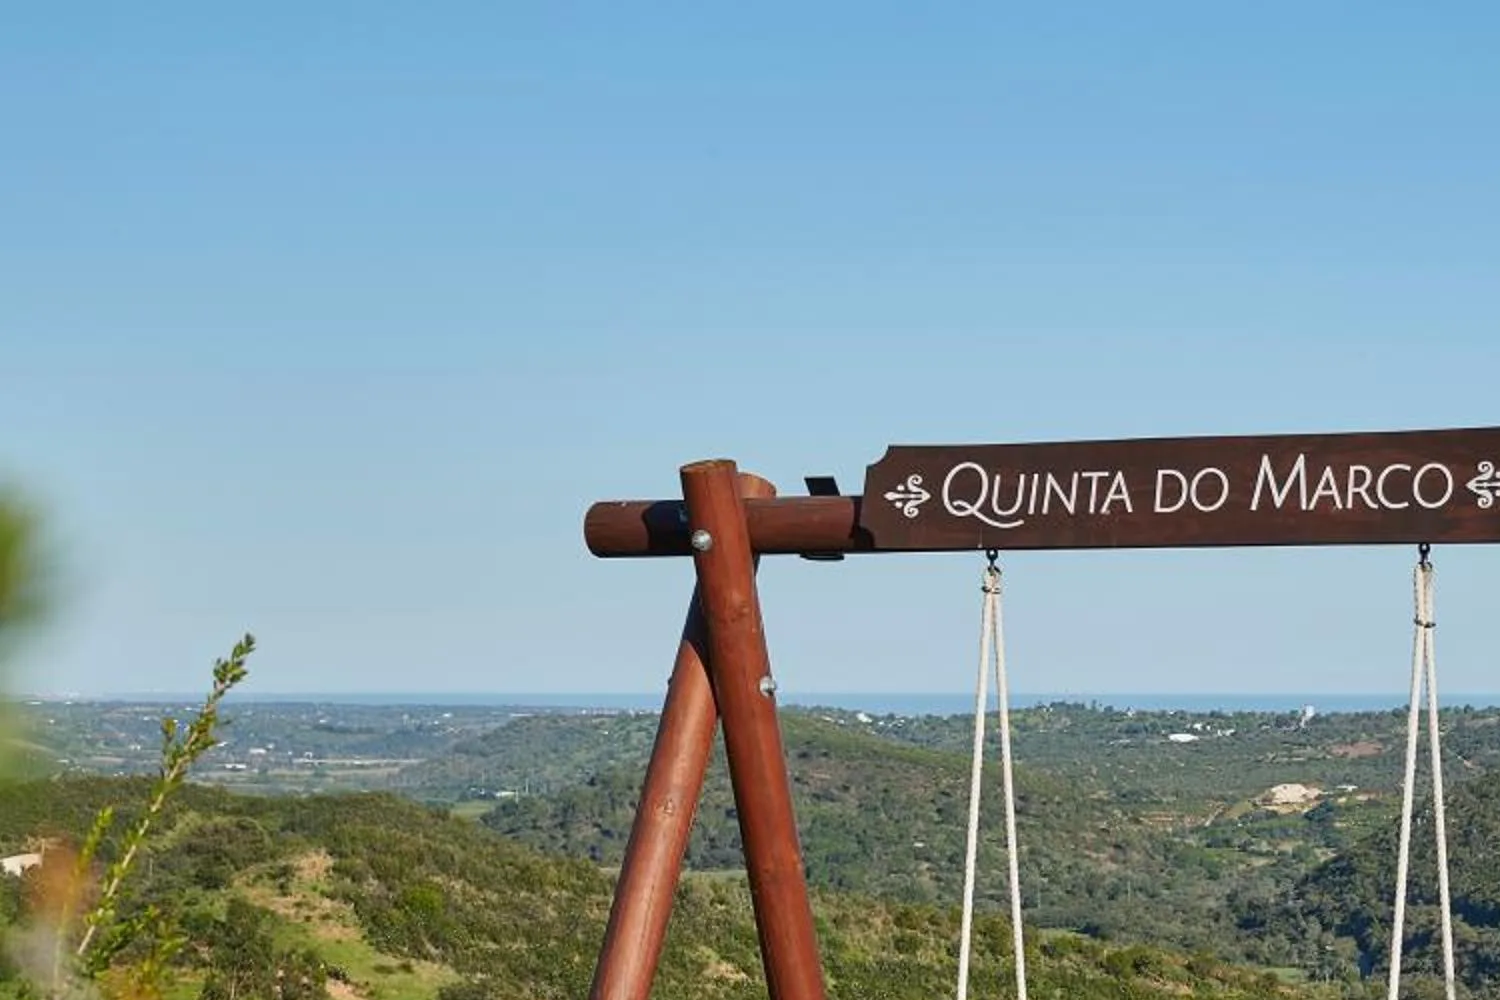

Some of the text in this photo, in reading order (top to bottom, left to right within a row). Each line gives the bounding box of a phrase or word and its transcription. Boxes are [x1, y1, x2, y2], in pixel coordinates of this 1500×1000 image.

[942, 453, 1454, 529] QUINTA DO MARCO
